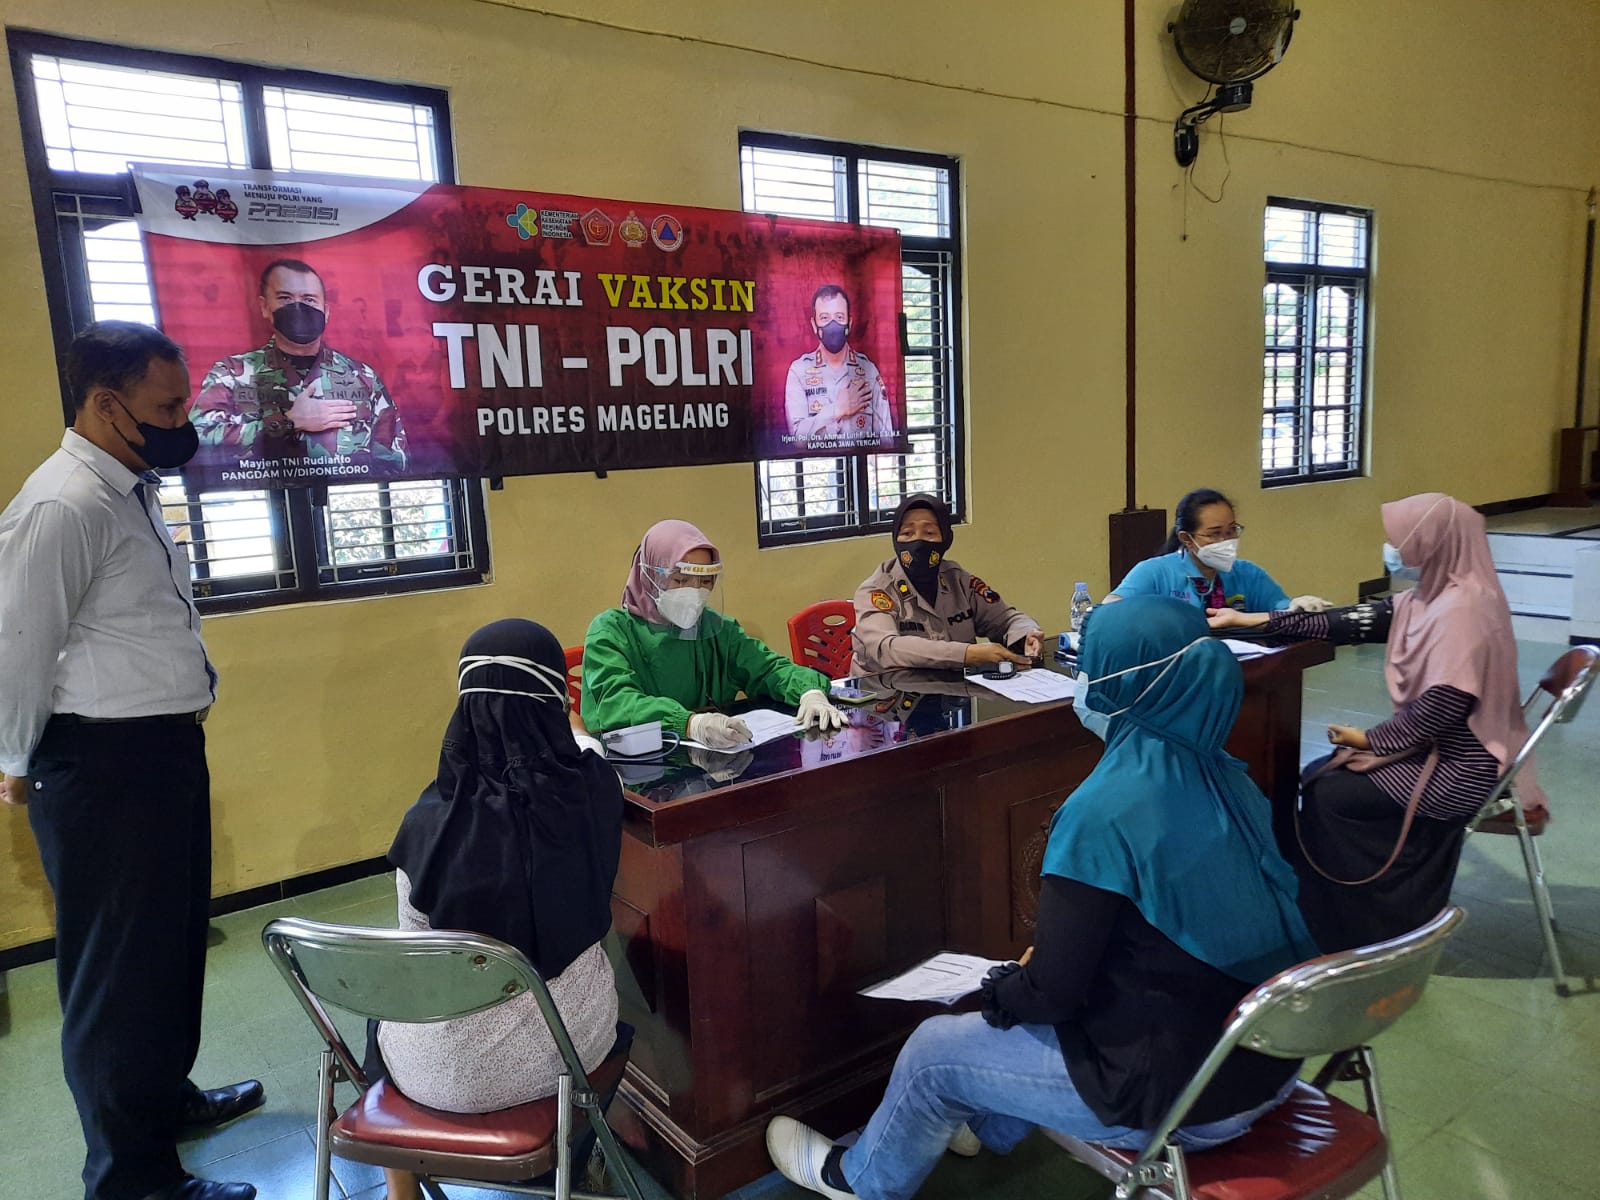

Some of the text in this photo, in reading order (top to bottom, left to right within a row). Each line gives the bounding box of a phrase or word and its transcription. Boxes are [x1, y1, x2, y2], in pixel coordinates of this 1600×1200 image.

[243, 184, 302, 194] TRANSFORMASI
[244, 192, 323, 203] MENUJU POLRI YANG
[248, 202, 339, 220] PRESISI
[418, 264, 756, 312] GERAI VAKSIN
[432, 322, 543, 389] TNI
[606, 326, 754, 387] POLRI
[477, 403, 729, 436] POLRES MAGELANG
[240, 454, 351, 470] Mayjen TNI Rudianto
[222, 465, 369, 481] PANGDAM IV/DIPONEGORO
